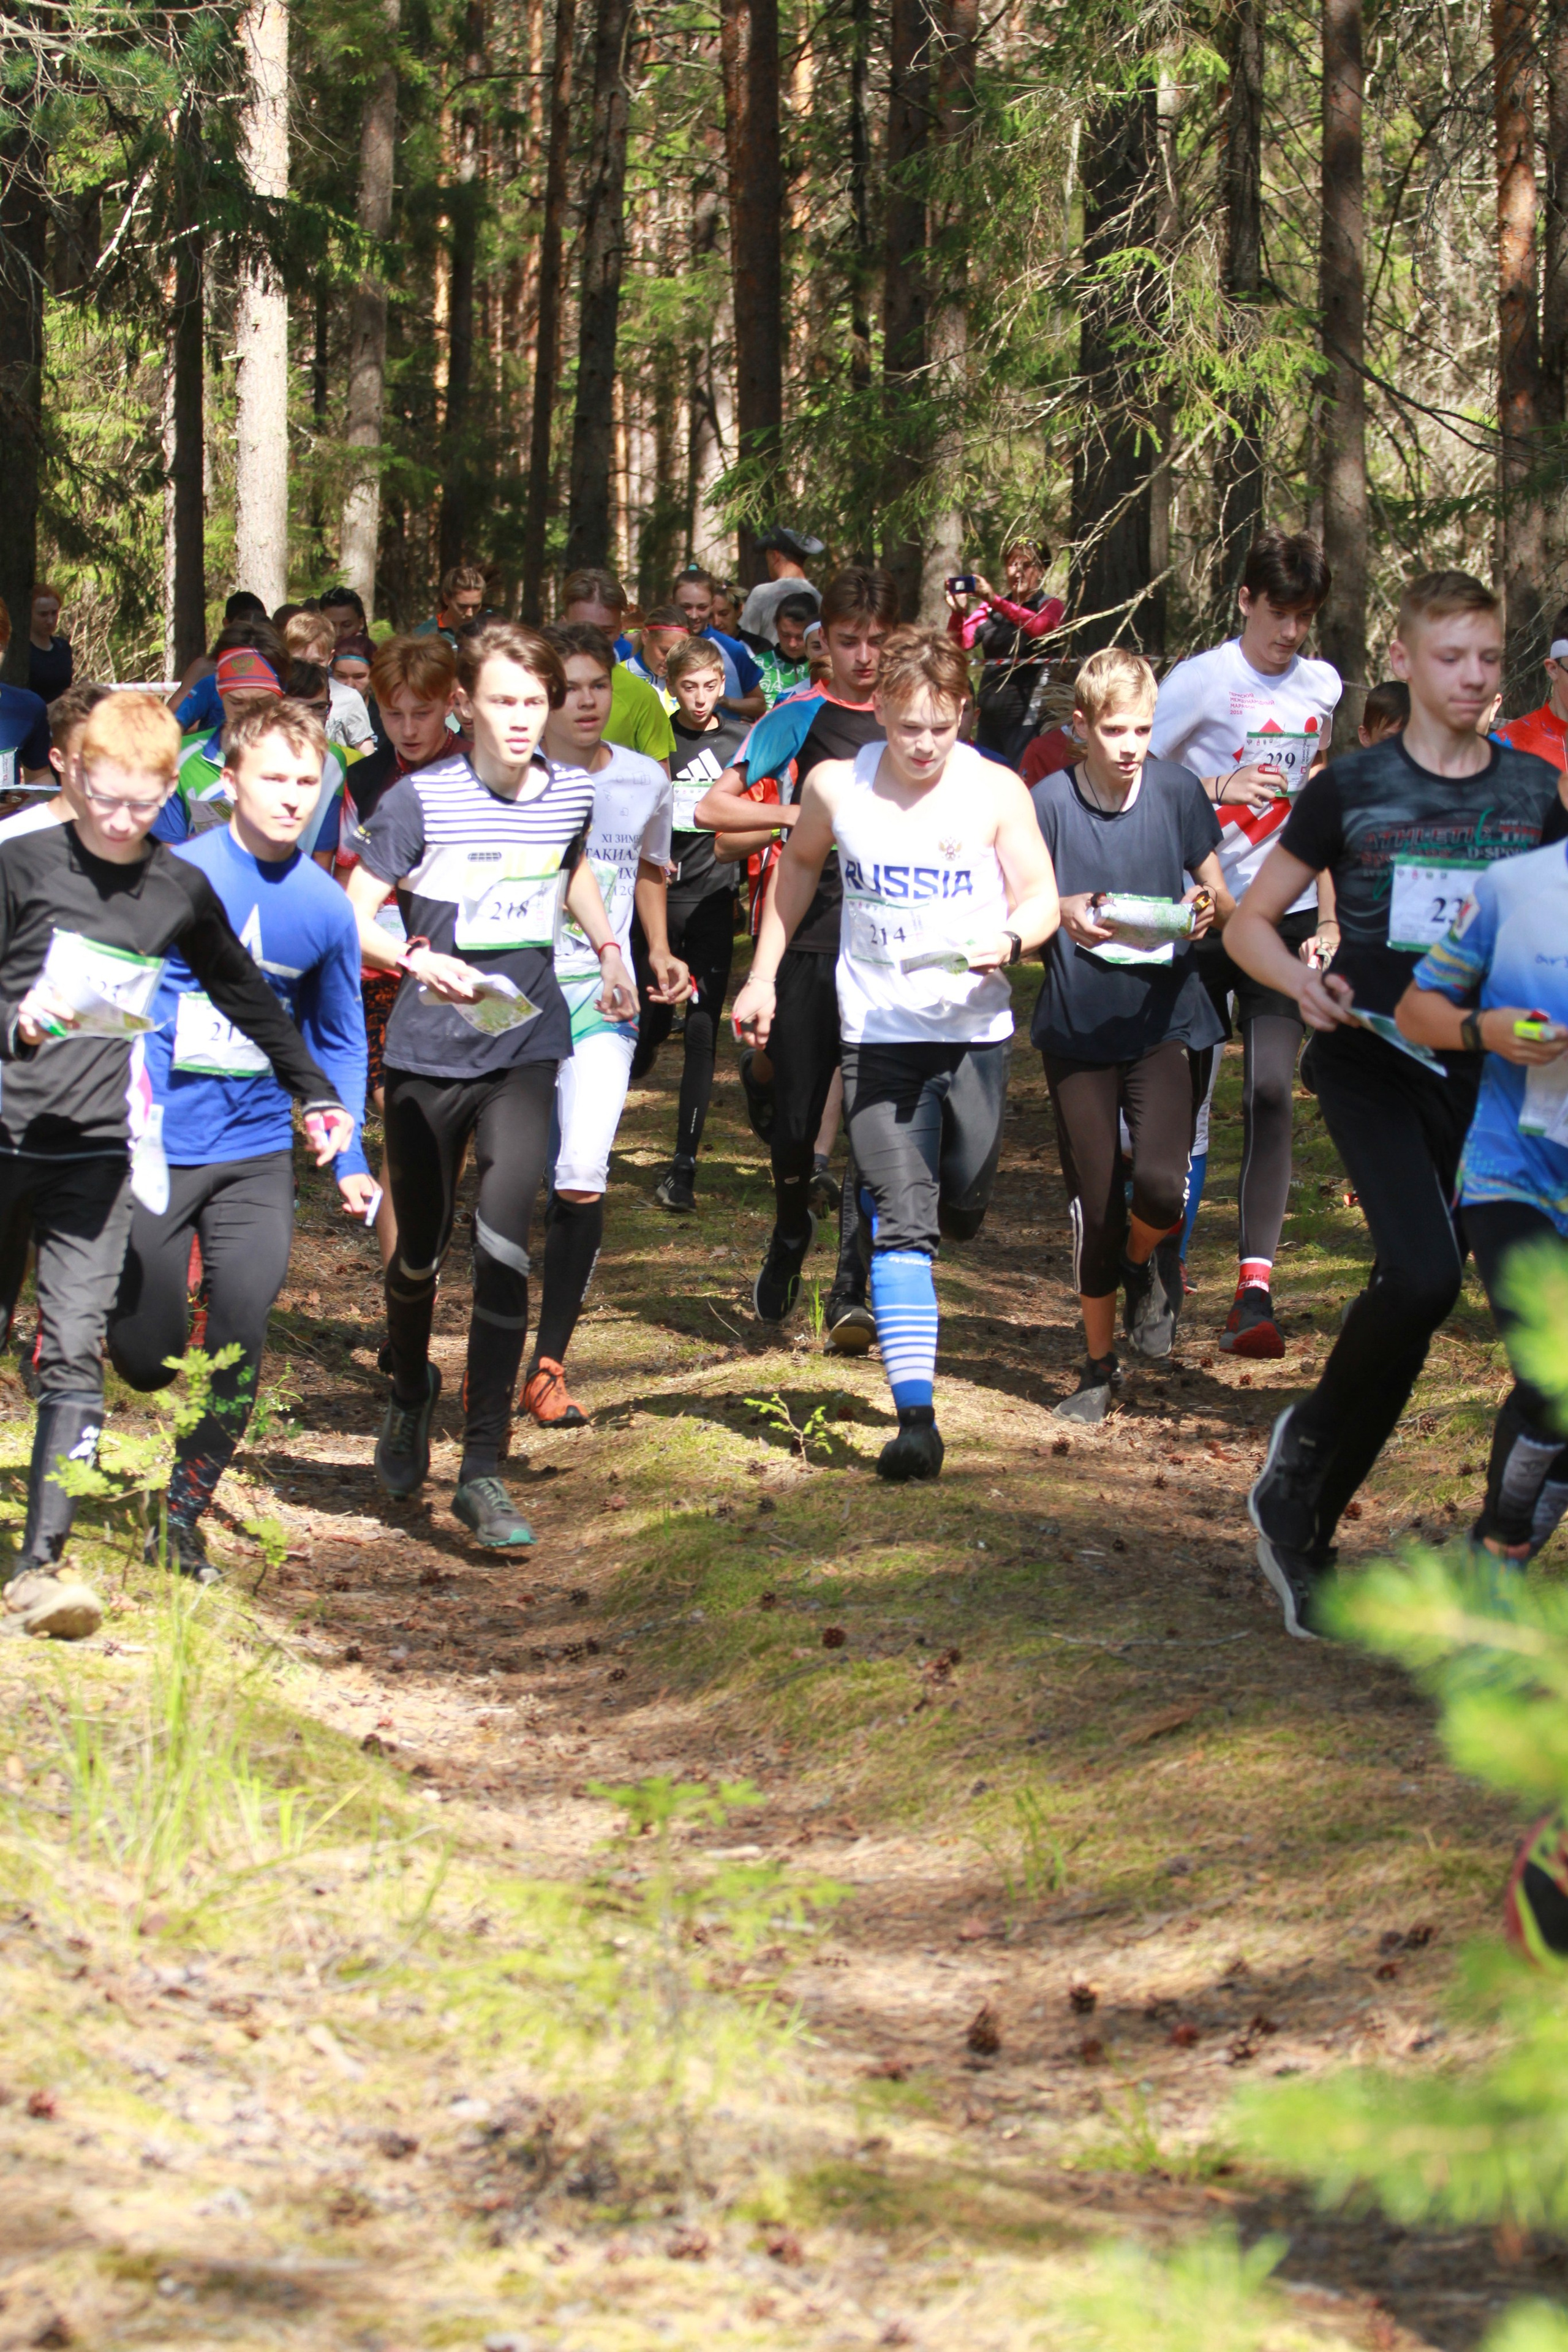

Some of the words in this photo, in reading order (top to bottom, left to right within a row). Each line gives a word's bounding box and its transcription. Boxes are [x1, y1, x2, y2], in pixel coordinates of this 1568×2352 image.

[1266, 752, 1295, 769] 229
[845, 859, 973, 899] RUSSIA
[490, 900, 529, 921] 218
[870, 924, 906, 946] 214
